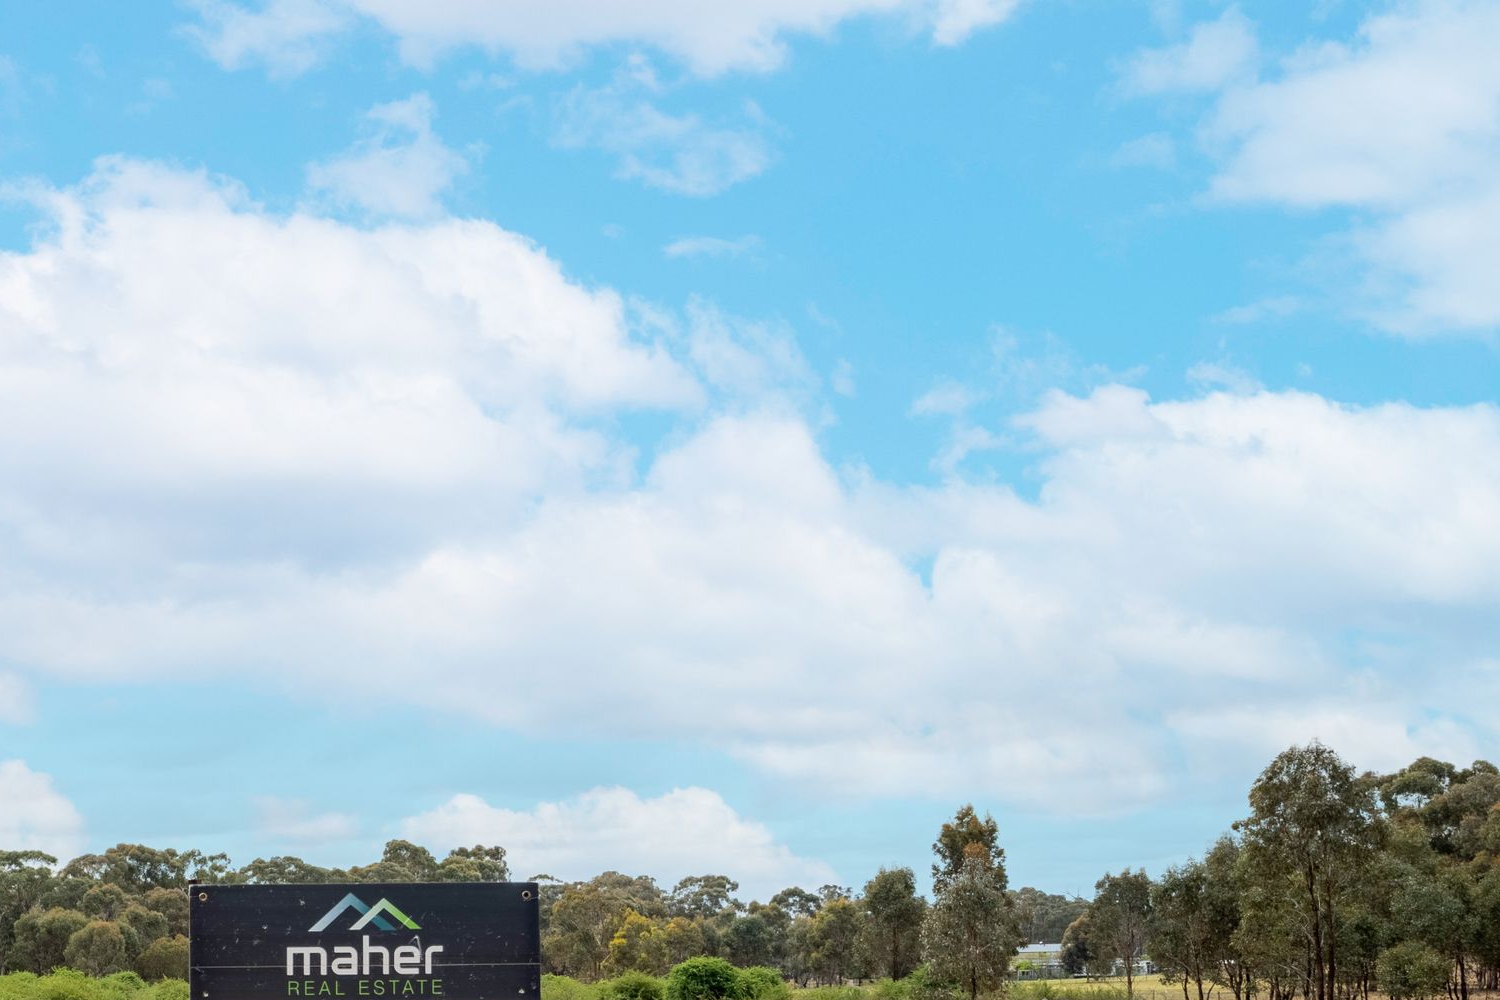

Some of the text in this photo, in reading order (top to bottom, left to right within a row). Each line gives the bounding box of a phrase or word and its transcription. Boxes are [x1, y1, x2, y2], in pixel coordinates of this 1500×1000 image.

[286, 935, 444, 976] maher
[287, 979, 444, 996] REAL ESTATE
